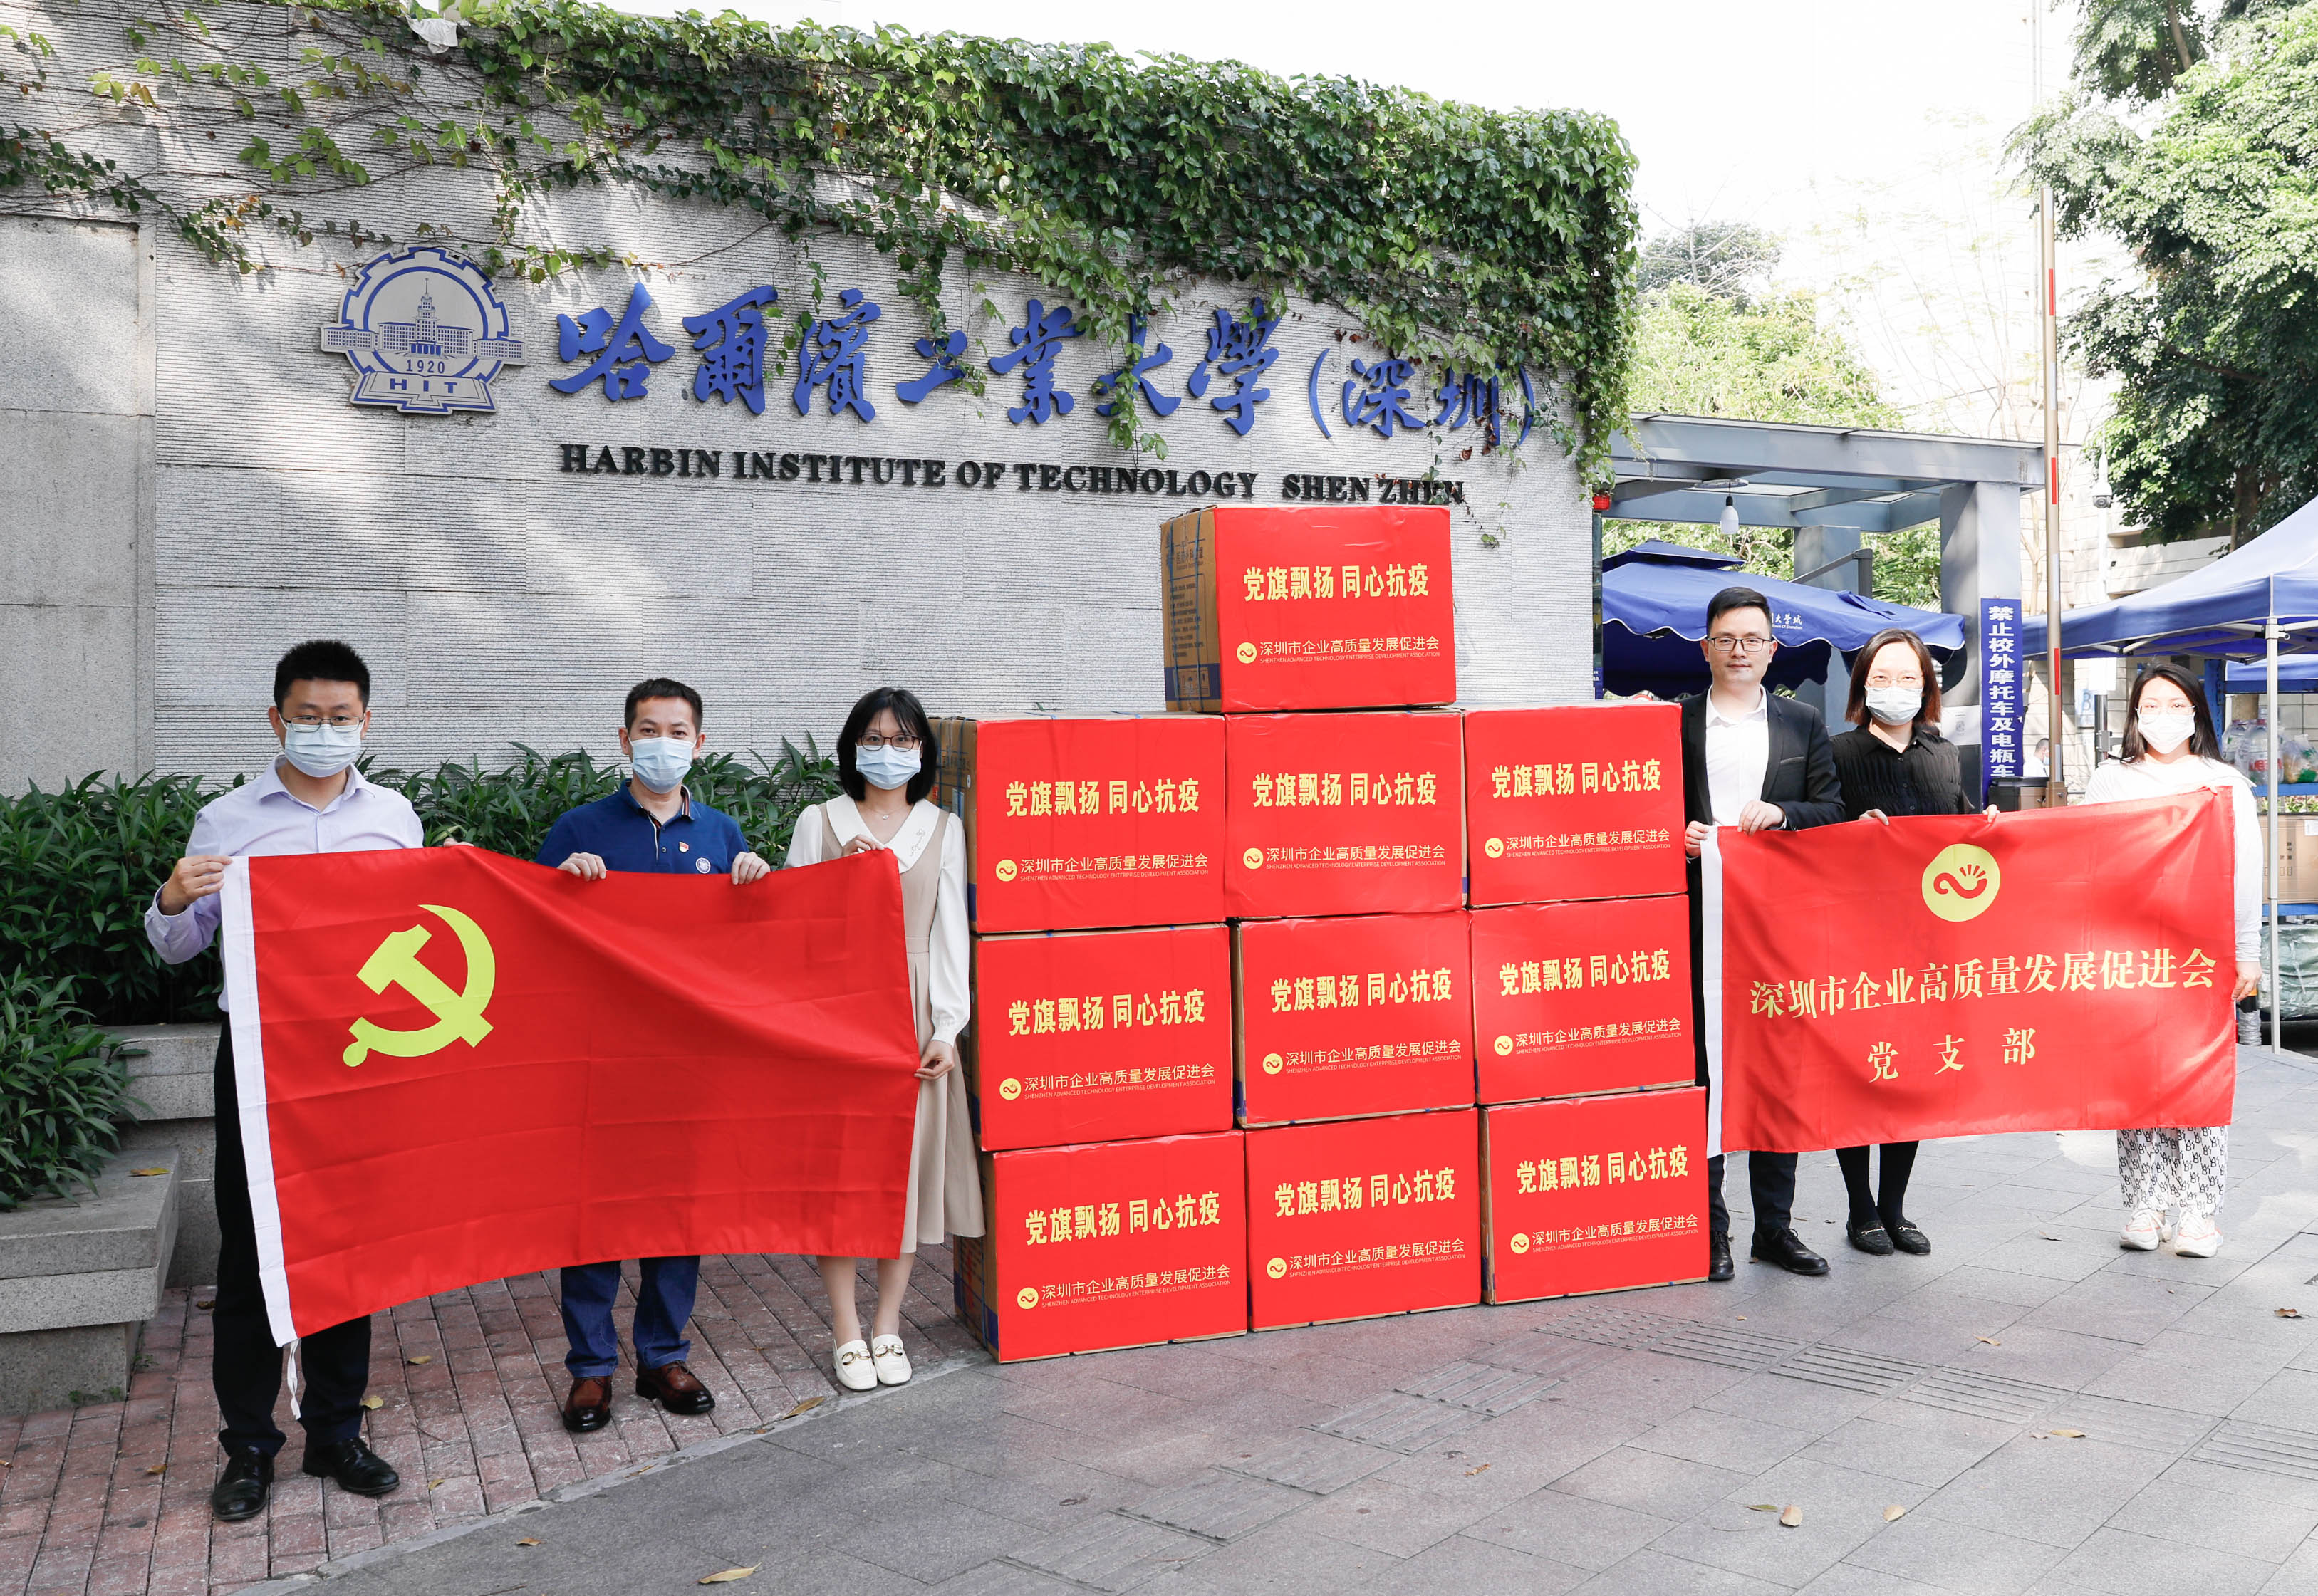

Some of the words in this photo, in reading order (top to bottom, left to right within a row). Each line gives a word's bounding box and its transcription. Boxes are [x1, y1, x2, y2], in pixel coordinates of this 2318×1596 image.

[406, 359, 445, 375] 1920
[389, 378, 458, 395] HIT
[560, 443, 722, 477] HARBIN
[734, 452, 946, 487] INSTITUTE
[957, 461, 1005, 490] OF
[1014, 464, 1259, 498] TECHNOLOGY
[1282, 474, 1373, 501] SHEN
[1243, 566, 1334, 601] 党旗飘扬
[1342, 563, 1429, 598] 同心抗疫
[1259, 636, 1439, 655] 深圳市企业高质量发展促进会
[1988, 606, 2016, 777] 禁止校外摩托车及电瓶车
[1252, 772, 1341, 808] 党旗飘扬
[1351, 772, 1436, 806] 同心抗疫
[1492, 763, 1574, 798] 党旗飘扬
[1582, 759, 1660, 793] 同心抗疫
[1006, 781, 1100, 817] 党旗飘扬
[1109, 778, 1199, 814] 同心抗疫
[1267, 845, 1445, 862] 深圳市企业高质量发展促进会
[1506, 828, 1670, 850] 深圳市企业高质量发展促进会
[1021, 853, 1208, 874] 深圳市企业高质量发展促进会
[1499, 957, 1583, 996] 党旗飘扬
[1590, 948, 1670, 987] 同心抗疫
[1750, 948, 2218, 1019] 深圳市企业高质量发展促进会
[1271, 974, 1359, 1013] 党旗飘扬
[1368, 967, 1452, 1006] 同心抗疫
[1009, 996, 1103, 1036] 党旗飘扬
[1113, 988, 1205, 1028] 同心抗疫
[1516, 1017, 1680, 1048] 深圳市企业高质量发展促进会
[1516, 1046, 1541, 1055] SHENZHEN
[1565, 1040, 1594, 1050] TECHNOLOGY
[1621, 1035, 1653, 1043] DEVELOPMENT
[1653, 1032, 1682, 1040] ASSOCIATION
[1286, 1039, 1461, 1066] 深圳市企业高质量发展促进会
[1338, 1061, 1369, 1070] TECHNOLOGY
[1369, 1059, 1398, 1068] ENTERPRISE
[1432, 1054, 1462, 1063] ASSOCIATION
[1024, 1063, 1215, 1091] 深圳市企业高质量发展促进会
[1024, 1091, 1054, 1100] SHENZHEN
[1081, 1086, 1115, 1095] TECHNOLOGY
[1116, 1084, 1145, 1092] ENTERPRISE
[1146, 1081, 1183, 1090] DEVELOPMENT
[1183, 1079, 1215, 1088] ASSOCIATION
[1517, 1155, 1600, 1194] 党旗飘扬
[1608, 1144, 1688, 1184] 同心抗疫
[1275, 1177, 1362, 1217] 党旗飘扬
[1371, 1167, 1455, 1208] 同心抗疫
[1025, 1202, 1120, 1246] 党旗飘扬
[1129, 1191, 1220, 1233] 同心抗疫
[1532, 1214, 1698, 1246] 深圳市企业高质量发展促进会
[1289, 1238, 1465, 1270] 深圳市企业高质量发展促进会
[1532, 1244, 1557, 1253] SHENZHEN
[1557, 1241, 1581, 1250] ADVANCED
[1581, 1238, 1611, 1247] TECHNOLOGY
[1611, 1235, 1638, 1244] ENTERPRISE
[1638, 1231, 1670, 1241] DEVELOPMENT
[1670, 1229, 1699, 1237] ASSOCIATION
[1289, 1269, 1316, 1278] SHENZHEN
[1316, 1266, 1341, 1275] ADVANCED
[1341, 1263, 1373, 1272] TECHNOLOGY
[1402, 1257, 1435, 1266] DEVELOPMENT
[1435, 1253, 1465, 1262] ASSOCIATION
[1041, 1264, 1230, 1300] 深圳市企业高质量发展促进会
[1041, 1298, 1070, 1308] SHENZHEN
[1070, 1295, 1097, 1305] ADVANCED
[1098, 1291, 1131, 1301] TECHNOLOGY
[1132, 1288, 1162, 1297] ENTERPRISE
[1163, 1283, 1198, 1293] DEVELOPMENT
[1199, 1279, 1231, 1289] ASSOCIATION
